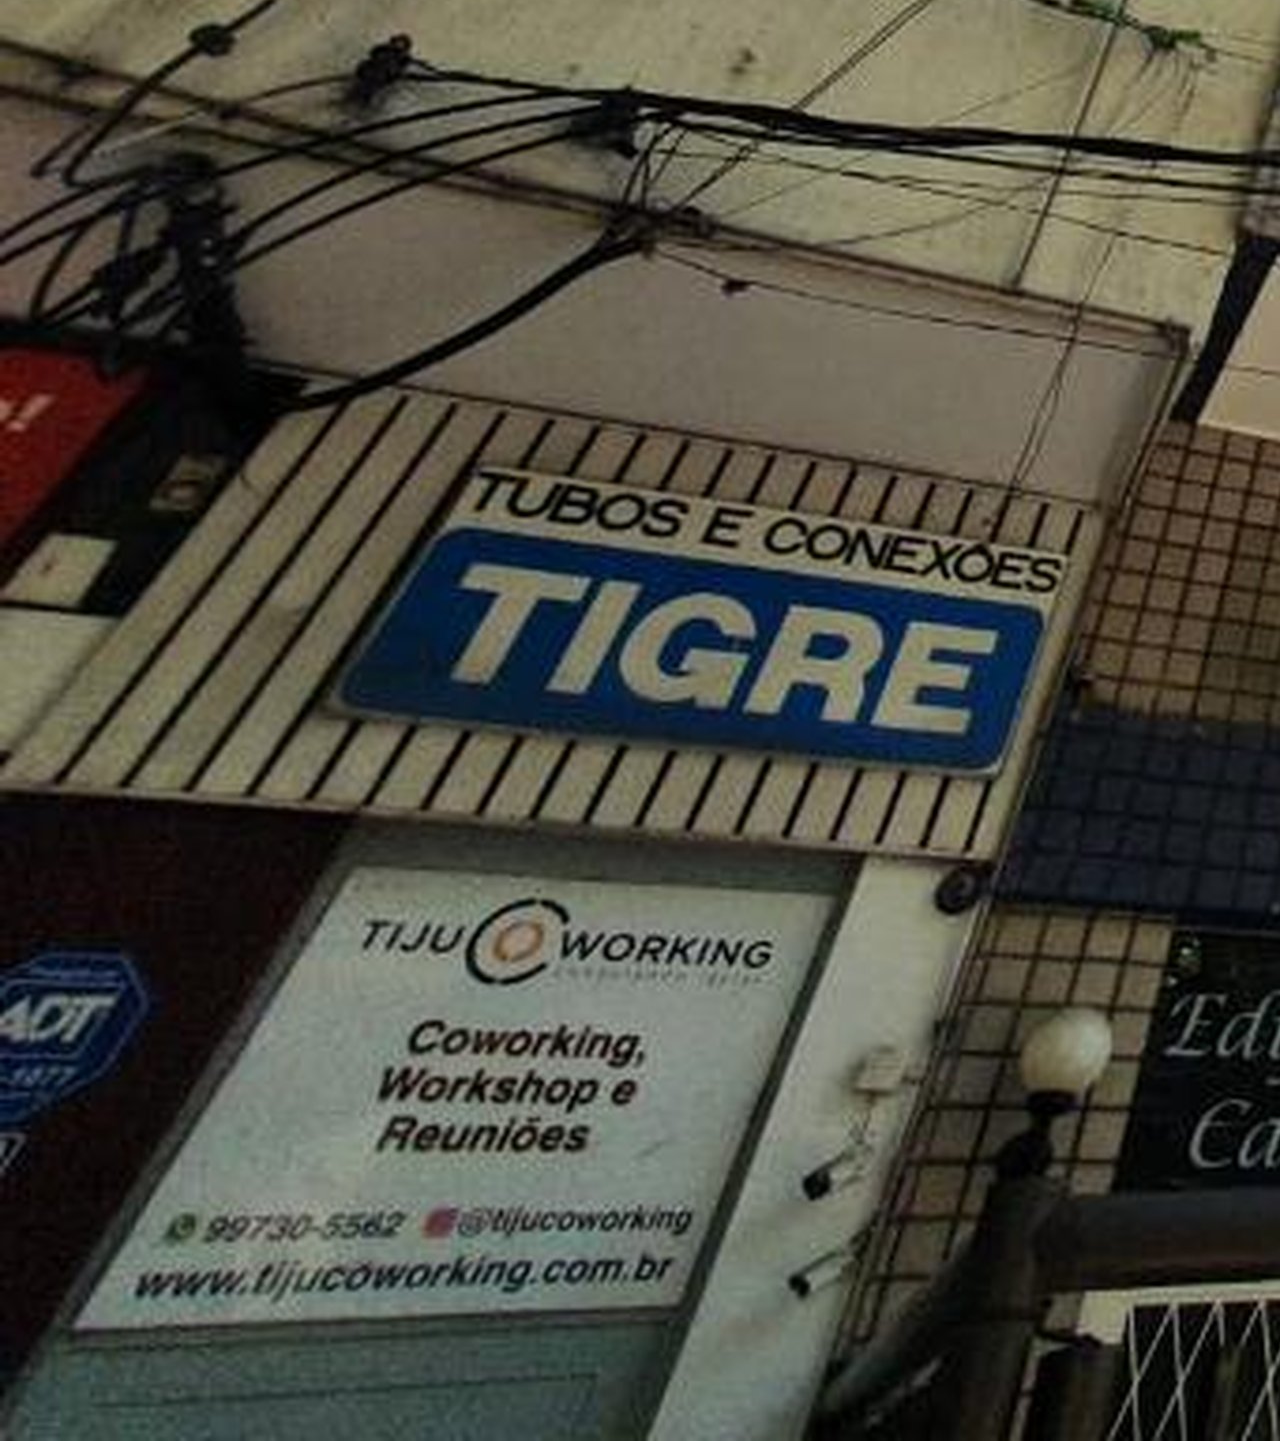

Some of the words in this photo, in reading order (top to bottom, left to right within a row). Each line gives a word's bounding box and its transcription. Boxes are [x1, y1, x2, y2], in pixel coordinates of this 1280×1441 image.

[474, 471, 689, 538] TUBOS
[702, 507, 755, 550] E
[763, 518, 1065, 594] CONEXÕES
[450, 562, 1000, 736] TIGRE
[0, 994, 117, 1044] ADT
[408, 1020, 645, 1070] Coworking,
[377, 1066, 599, 1114] Workshop
[610, 1079, 637, 1106] e
[374, 1116, 591, 1153] Reuniões
[203, 1210, 407, 1244] 99730-5562
[456, 1205, 693, 1238] @tijucoworking
[134, 1255, 672, 1304] www.tijucoworking.com.br
